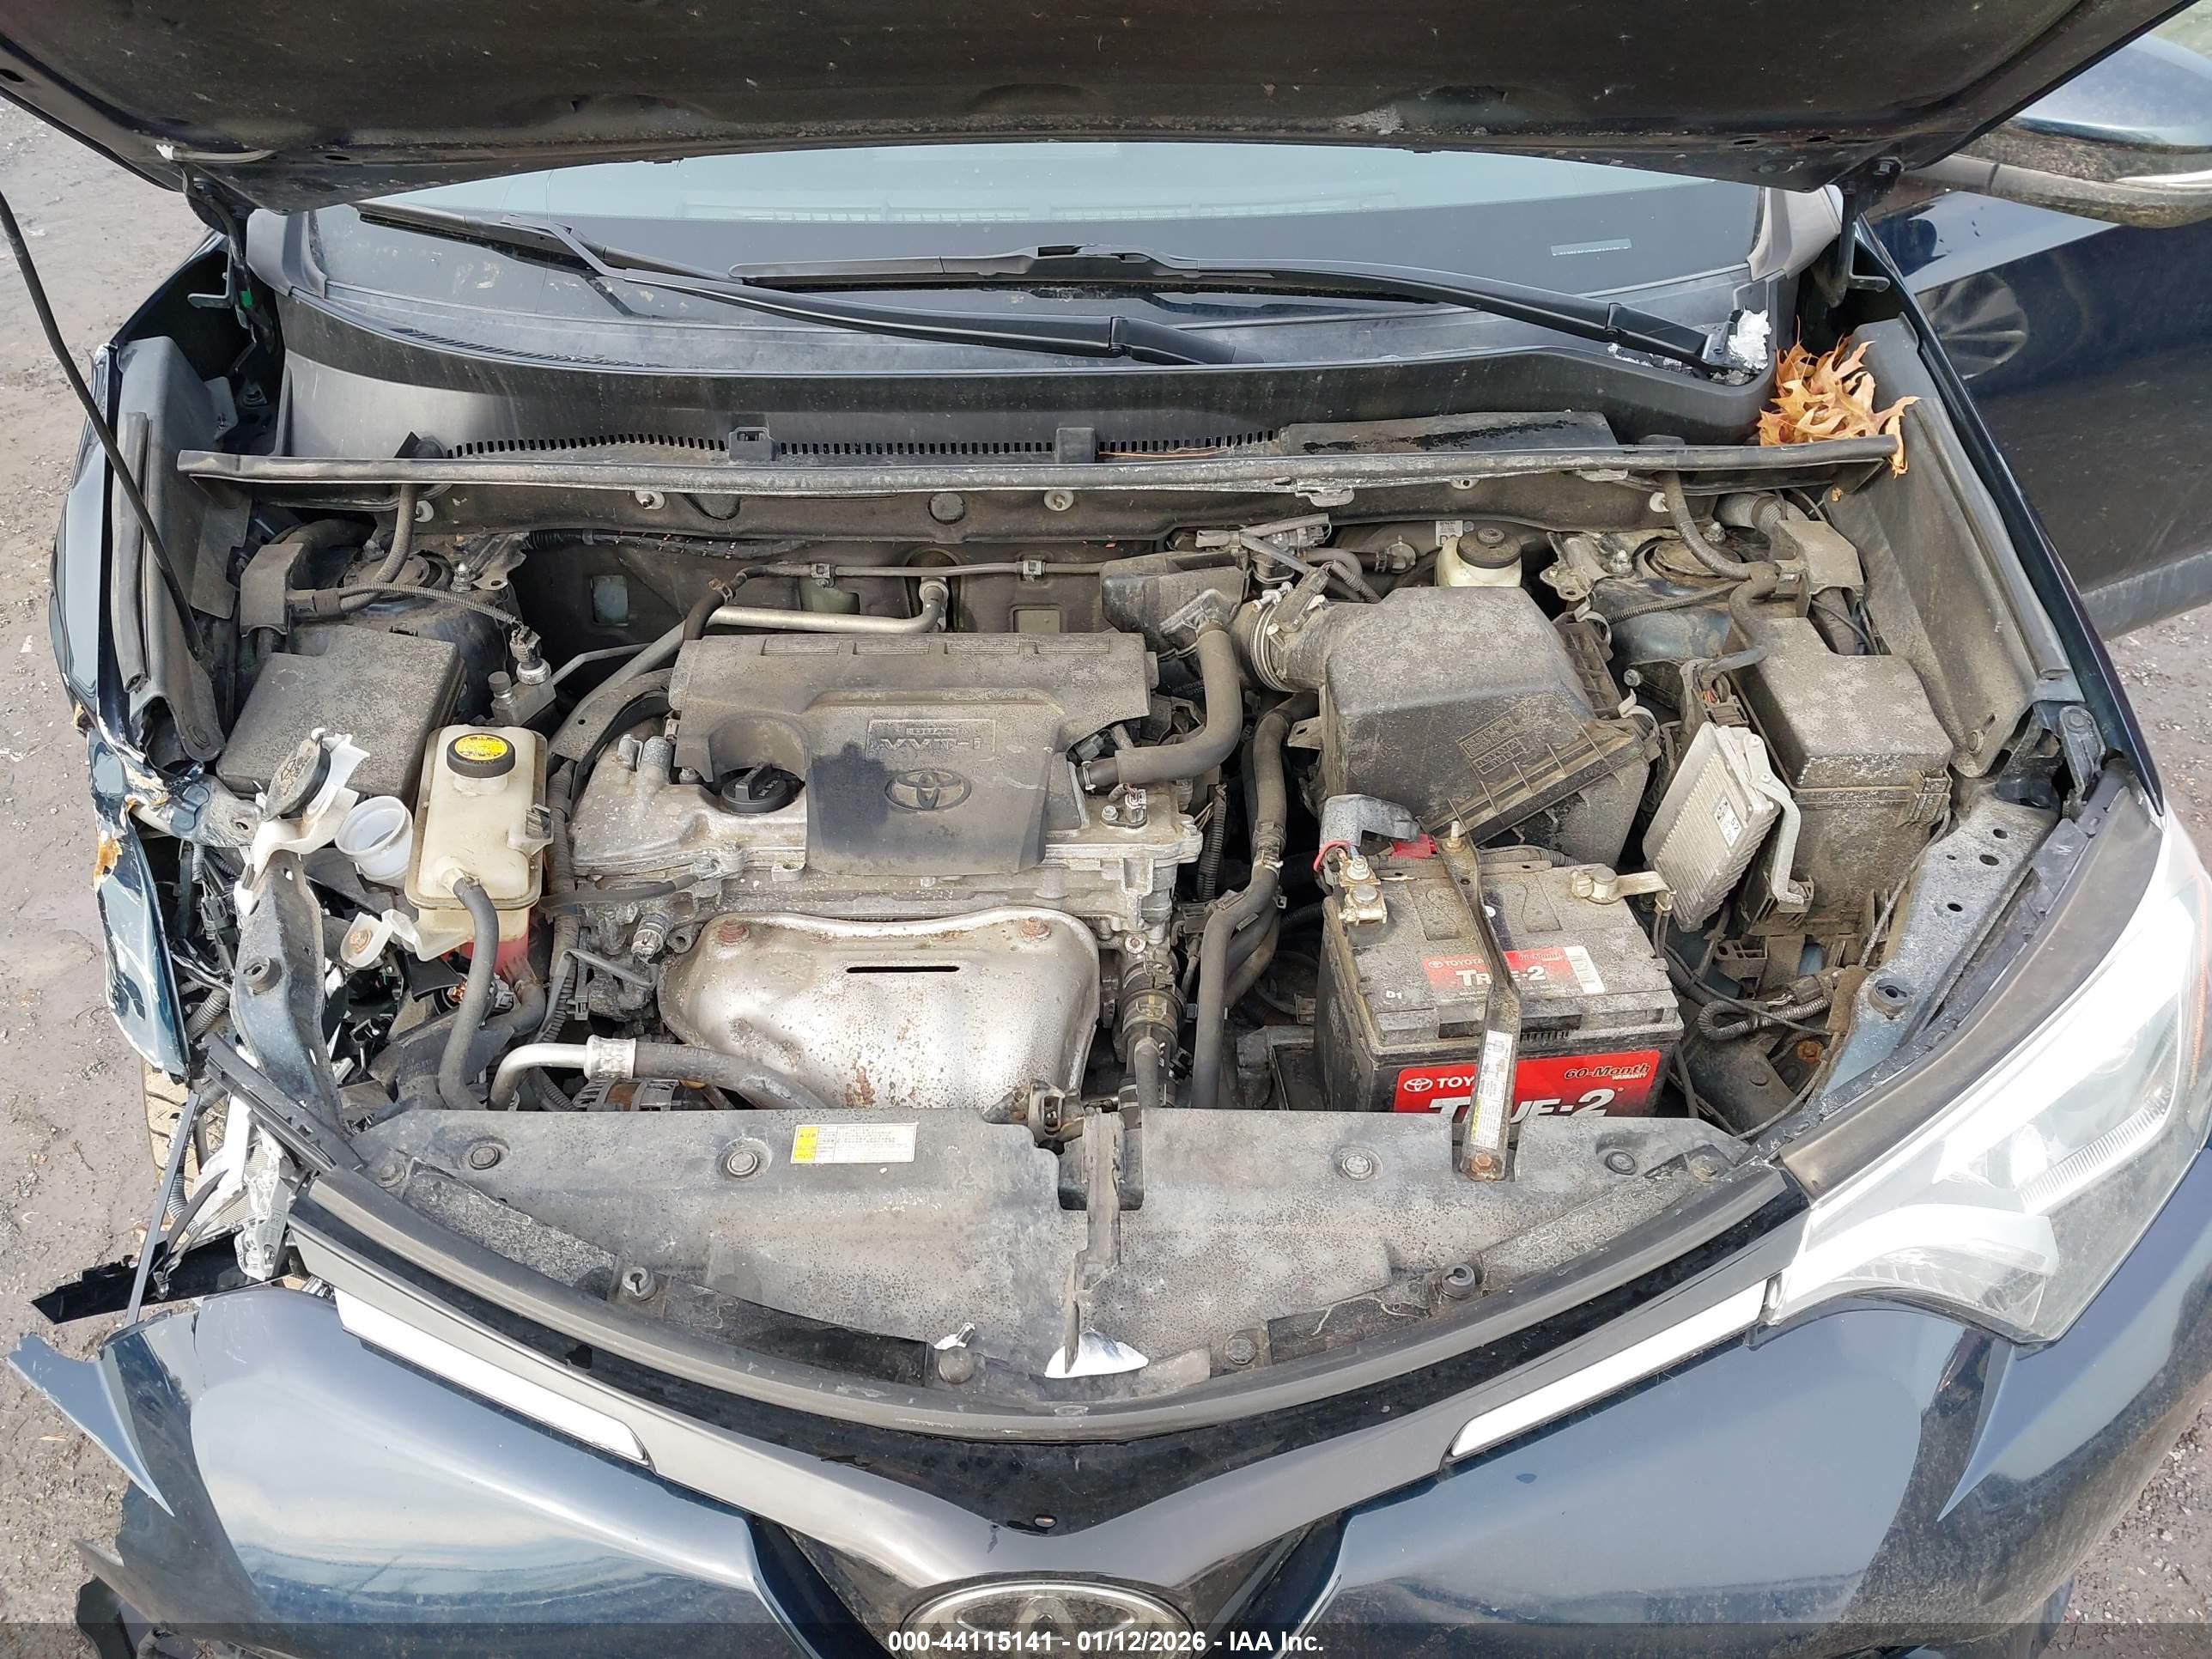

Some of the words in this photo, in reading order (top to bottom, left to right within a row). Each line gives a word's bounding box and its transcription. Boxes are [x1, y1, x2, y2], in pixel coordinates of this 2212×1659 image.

[1444, 957, 1485, 967] TOYOTA
[1455, 965, 1547, 987] TRE-2
[1565, 1063, 1651, 1079] 60-Month
[1437, 1075, 1475, 1089] TOY
[1428, 1088, 1616, 1124] TUE-2
